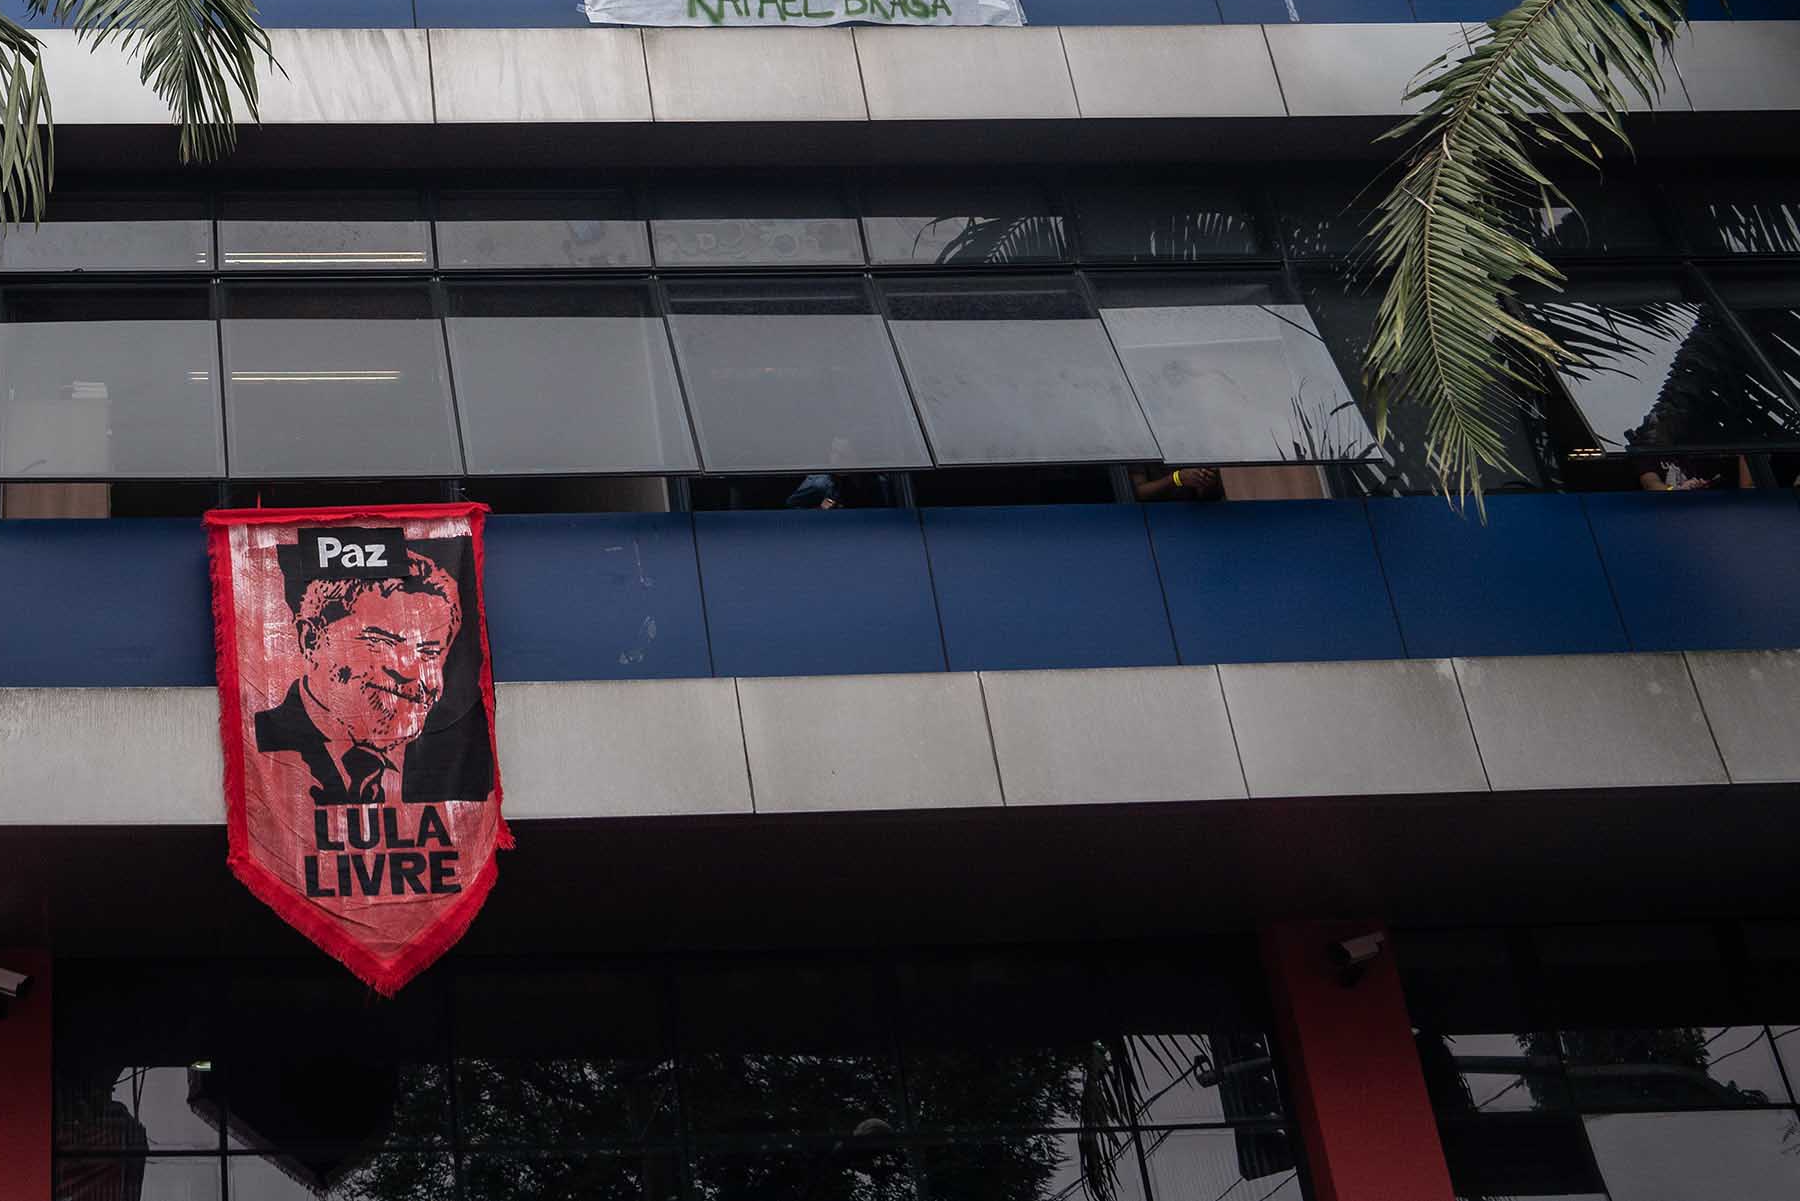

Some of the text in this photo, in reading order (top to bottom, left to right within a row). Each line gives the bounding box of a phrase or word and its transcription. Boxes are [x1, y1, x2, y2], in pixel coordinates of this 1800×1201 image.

[317, 536, 389, 571] Paz
[313, 804, 452, 852] LULA
[305, 851, 462, 898] LIVRE
